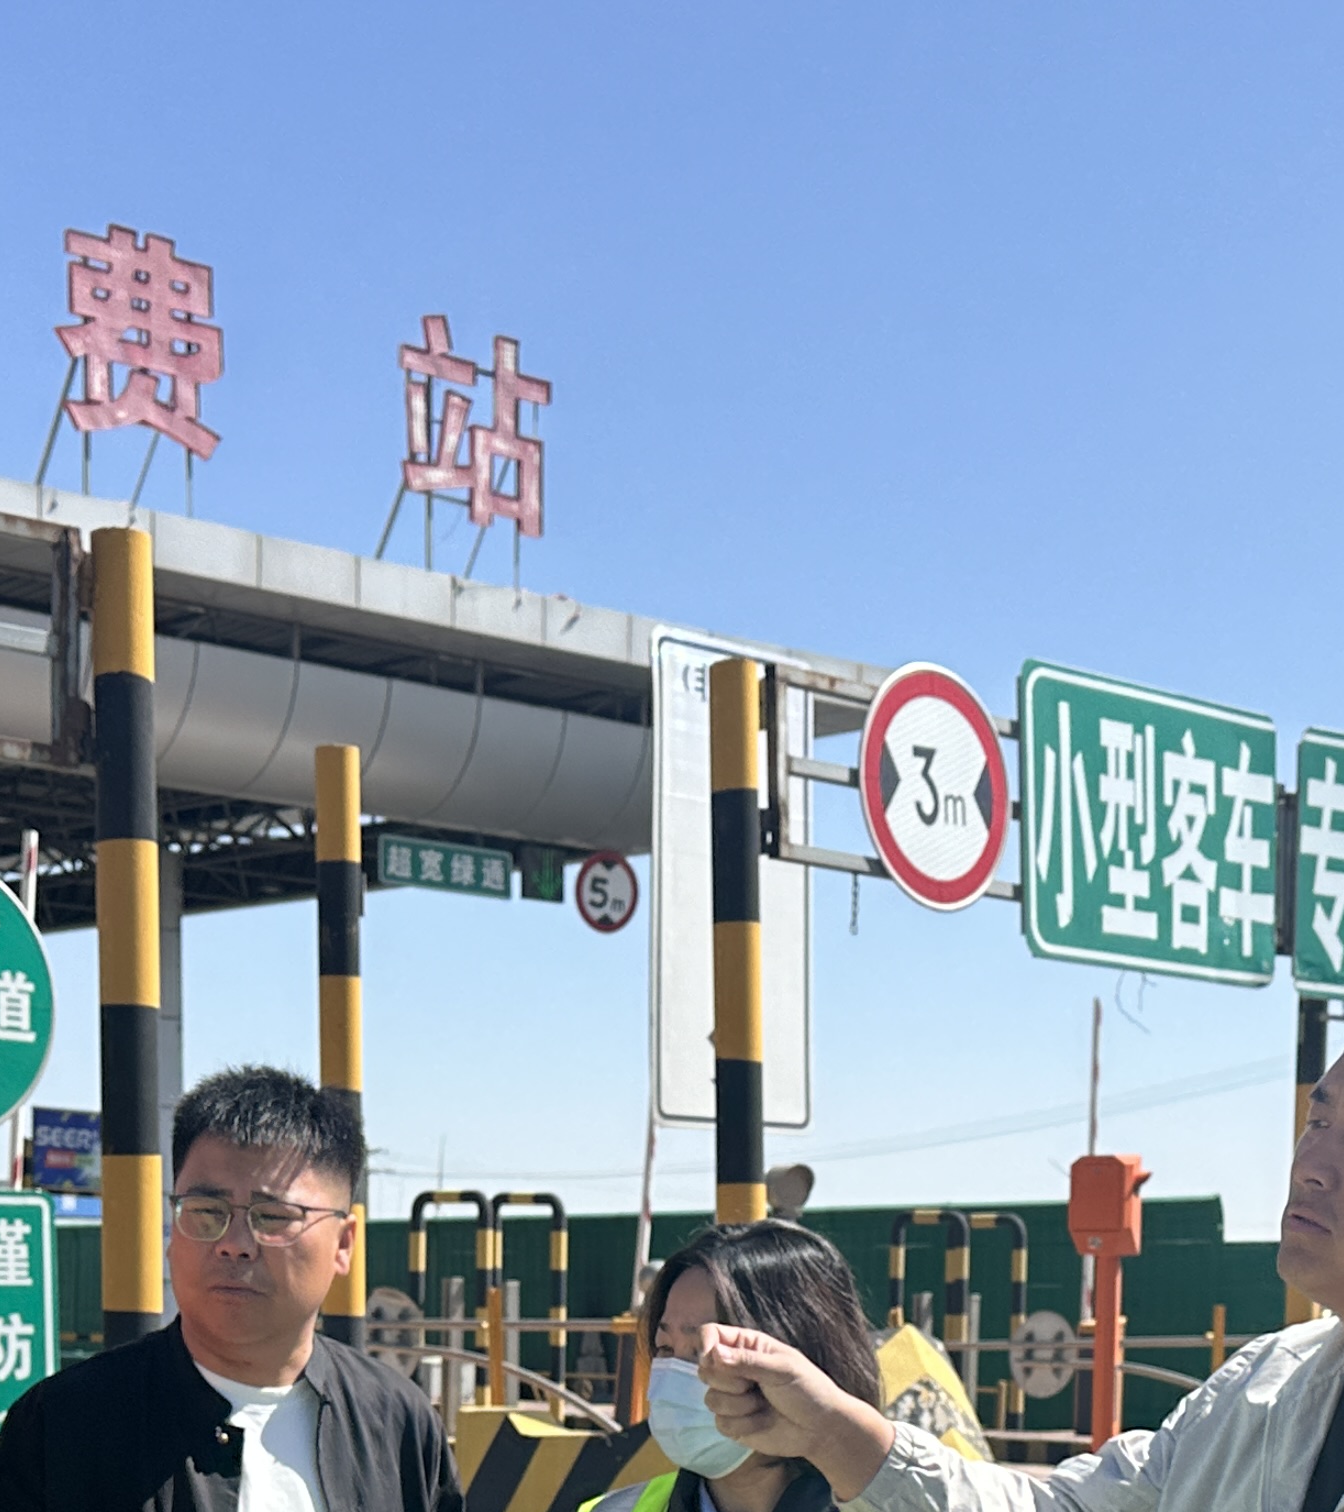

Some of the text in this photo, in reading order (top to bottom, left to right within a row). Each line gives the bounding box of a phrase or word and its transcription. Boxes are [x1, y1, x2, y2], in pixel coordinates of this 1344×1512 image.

[910, 744, 967, 829] 3m
[1037, 700, 1273, 959] 小型客车
[588, 877, 626, 912] 5m
